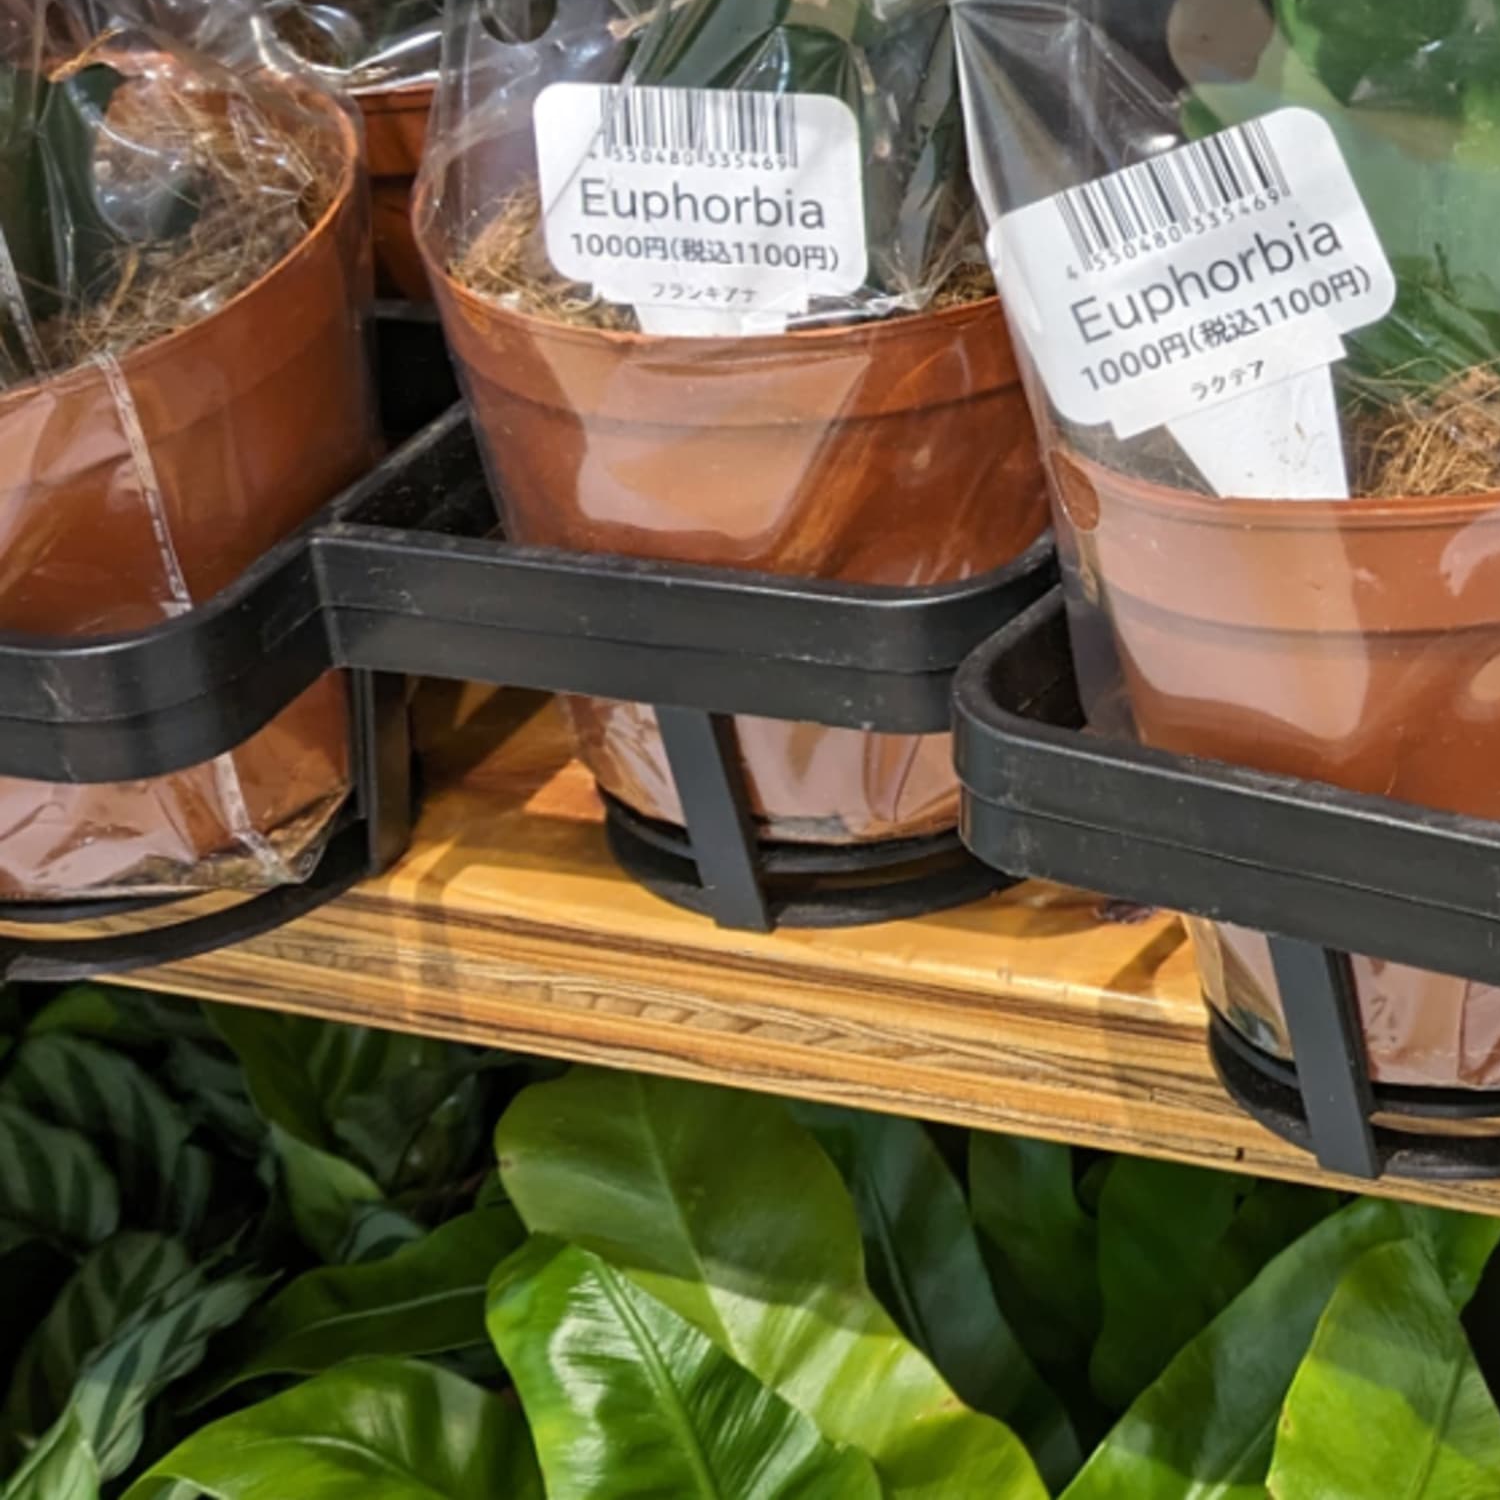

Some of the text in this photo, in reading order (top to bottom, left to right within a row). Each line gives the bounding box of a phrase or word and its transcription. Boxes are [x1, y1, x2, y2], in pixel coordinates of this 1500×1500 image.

[580, 177, 825, 230] Euphorbia
[571, 233, 839, 271] 1000円(税込1100円)
[1070, 219, 1343, 344] Euphorbia
[1079, 264, 1373, 392] 1000円(税込1100円)
